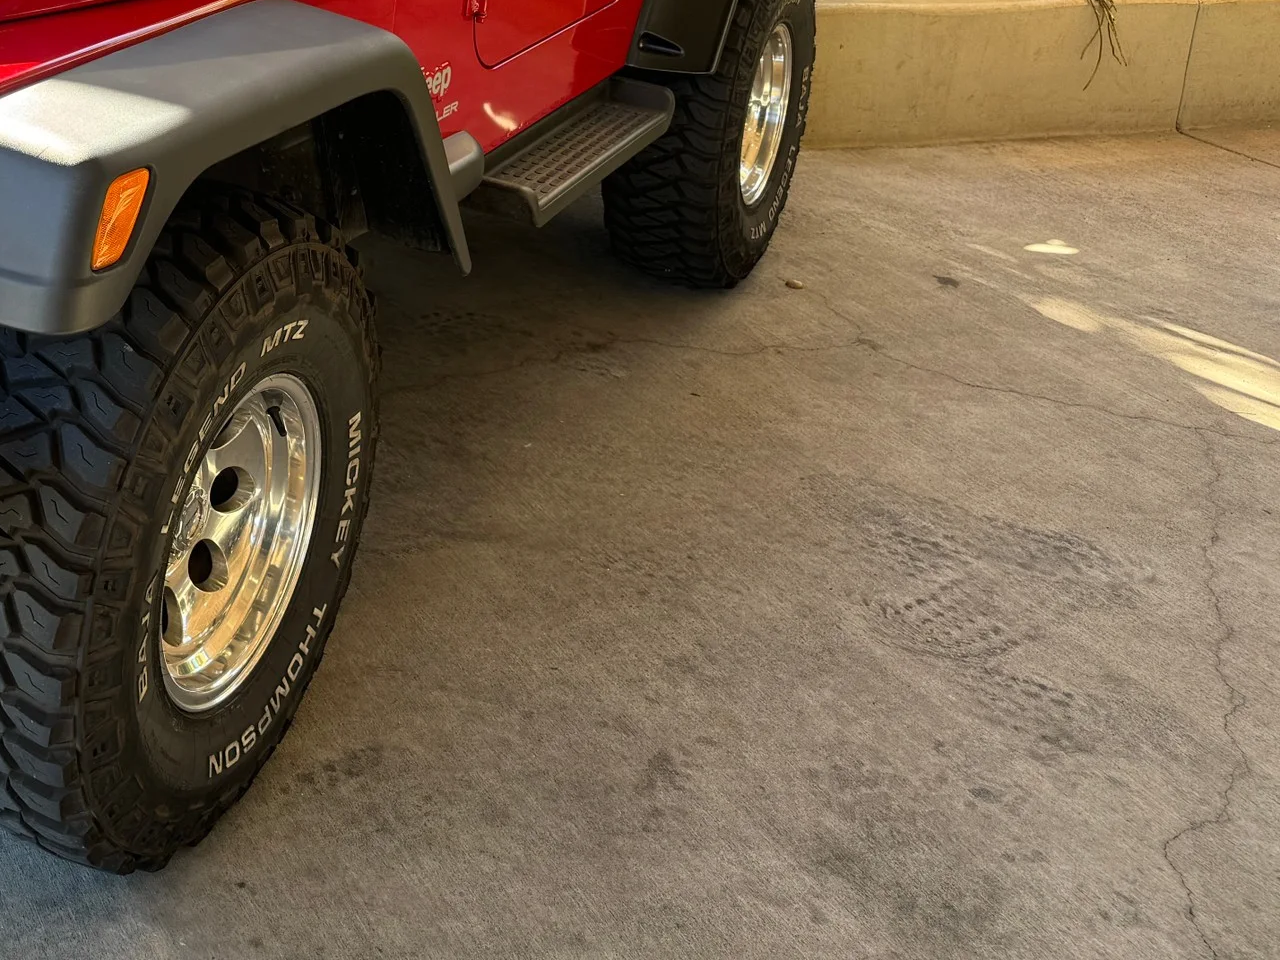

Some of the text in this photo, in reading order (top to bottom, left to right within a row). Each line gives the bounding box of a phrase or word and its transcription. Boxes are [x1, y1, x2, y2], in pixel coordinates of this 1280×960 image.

[423, 65, 452, 97] eep
[160, 361, 247, 534] LEGEND
[260, 319, 309, 358] MTZ
[208, 410, 362, 779] MICKEY THOMPSON
